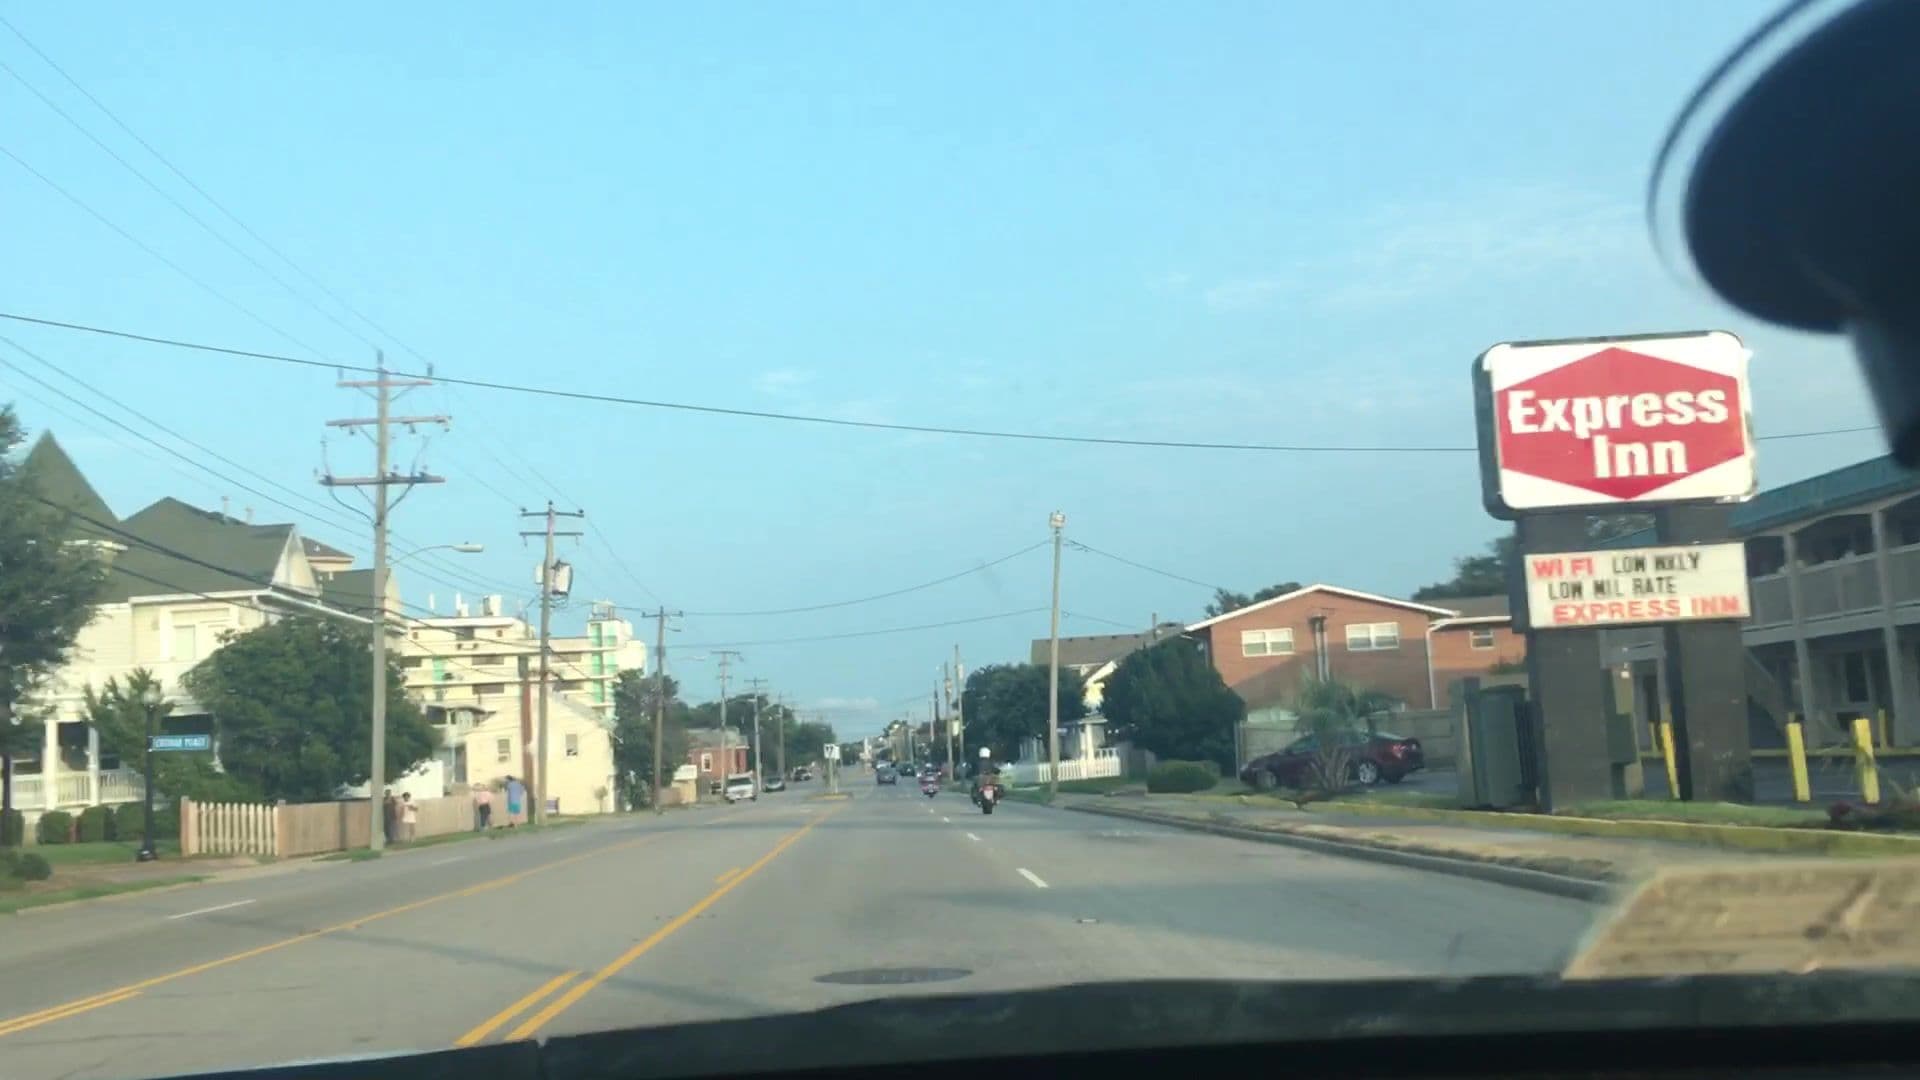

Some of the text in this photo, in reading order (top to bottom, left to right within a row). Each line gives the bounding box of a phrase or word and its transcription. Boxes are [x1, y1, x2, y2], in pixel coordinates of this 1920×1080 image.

[1508, 390, 1728, 439] Express
[1593, 434, 1688, 478] Inn
[1532, 558, 1563, 578] WI
[1571, 557, 1593, 577] FI
[1612, 555, 1646, 574] LOW
[1548, 581, 1583, 600] LOW
[1632, 576, 1678, 595] RATE
[1553, 596, 1739, 624] EXPRESS INN
